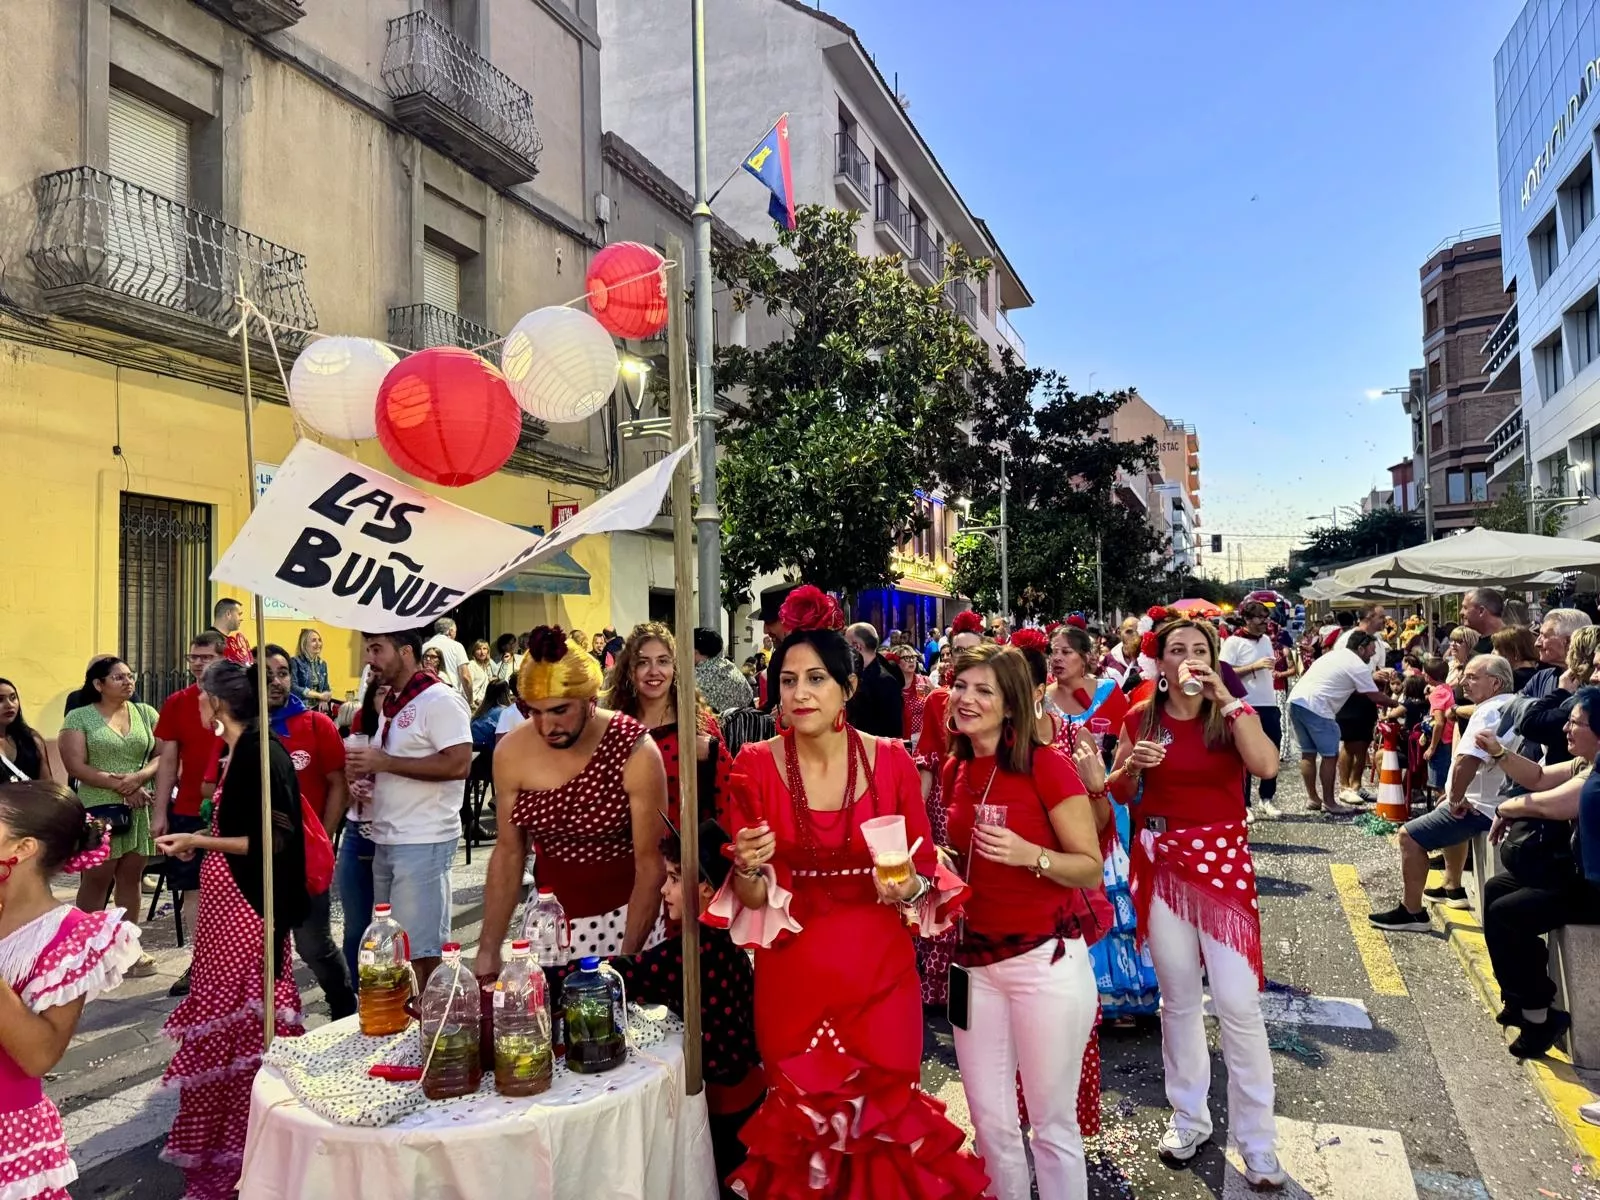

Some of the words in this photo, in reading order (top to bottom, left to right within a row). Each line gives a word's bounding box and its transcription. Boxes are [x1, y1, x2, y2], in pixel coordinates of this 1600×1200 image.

[1520, 141, 1550, 212] HOTEL
[308, 472, 426, 544] LAS
[275, 527, 466, 618] BUÑUE
